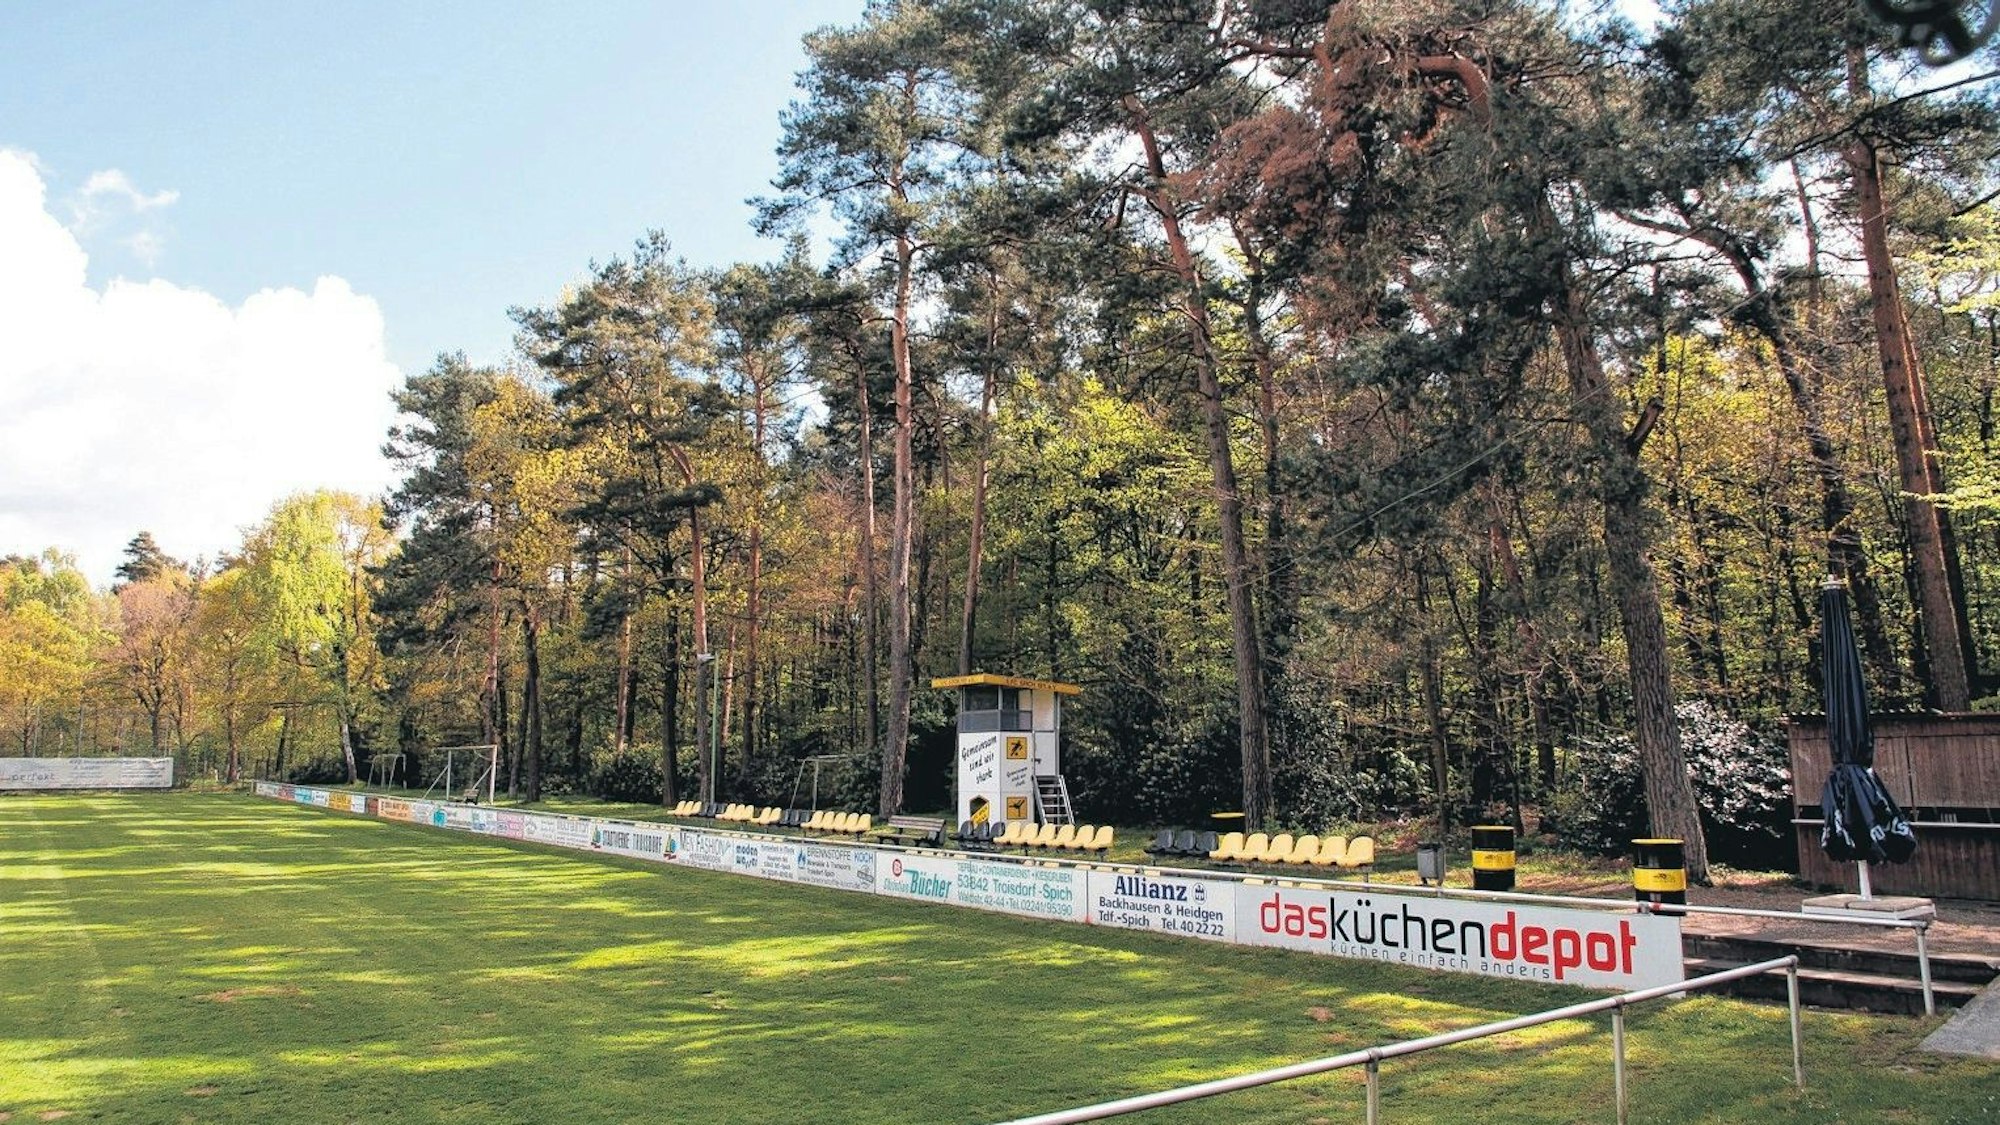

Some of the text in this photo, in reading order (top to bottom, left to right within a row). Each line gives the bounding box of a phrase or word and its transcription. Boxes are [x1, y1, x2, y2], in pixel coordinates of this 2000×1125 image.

[903, 869, 952, 899] Bücher
[957, 874, 989, 892] 53842
[993, 878, 1037, 898] Troisdorf
[1114, 875, 1188, 901] Allianz
[1099, 896, 1224, 923] Backhausen & Heidgen
[1099, 909, 1150, 928] Tdf.-Spich
[1161, 917, 1178, 930] Tel.
[1260, 892, 1637, 980] dasküchendepot
[1330, 940, 1551, 980] küchen einfach anders
